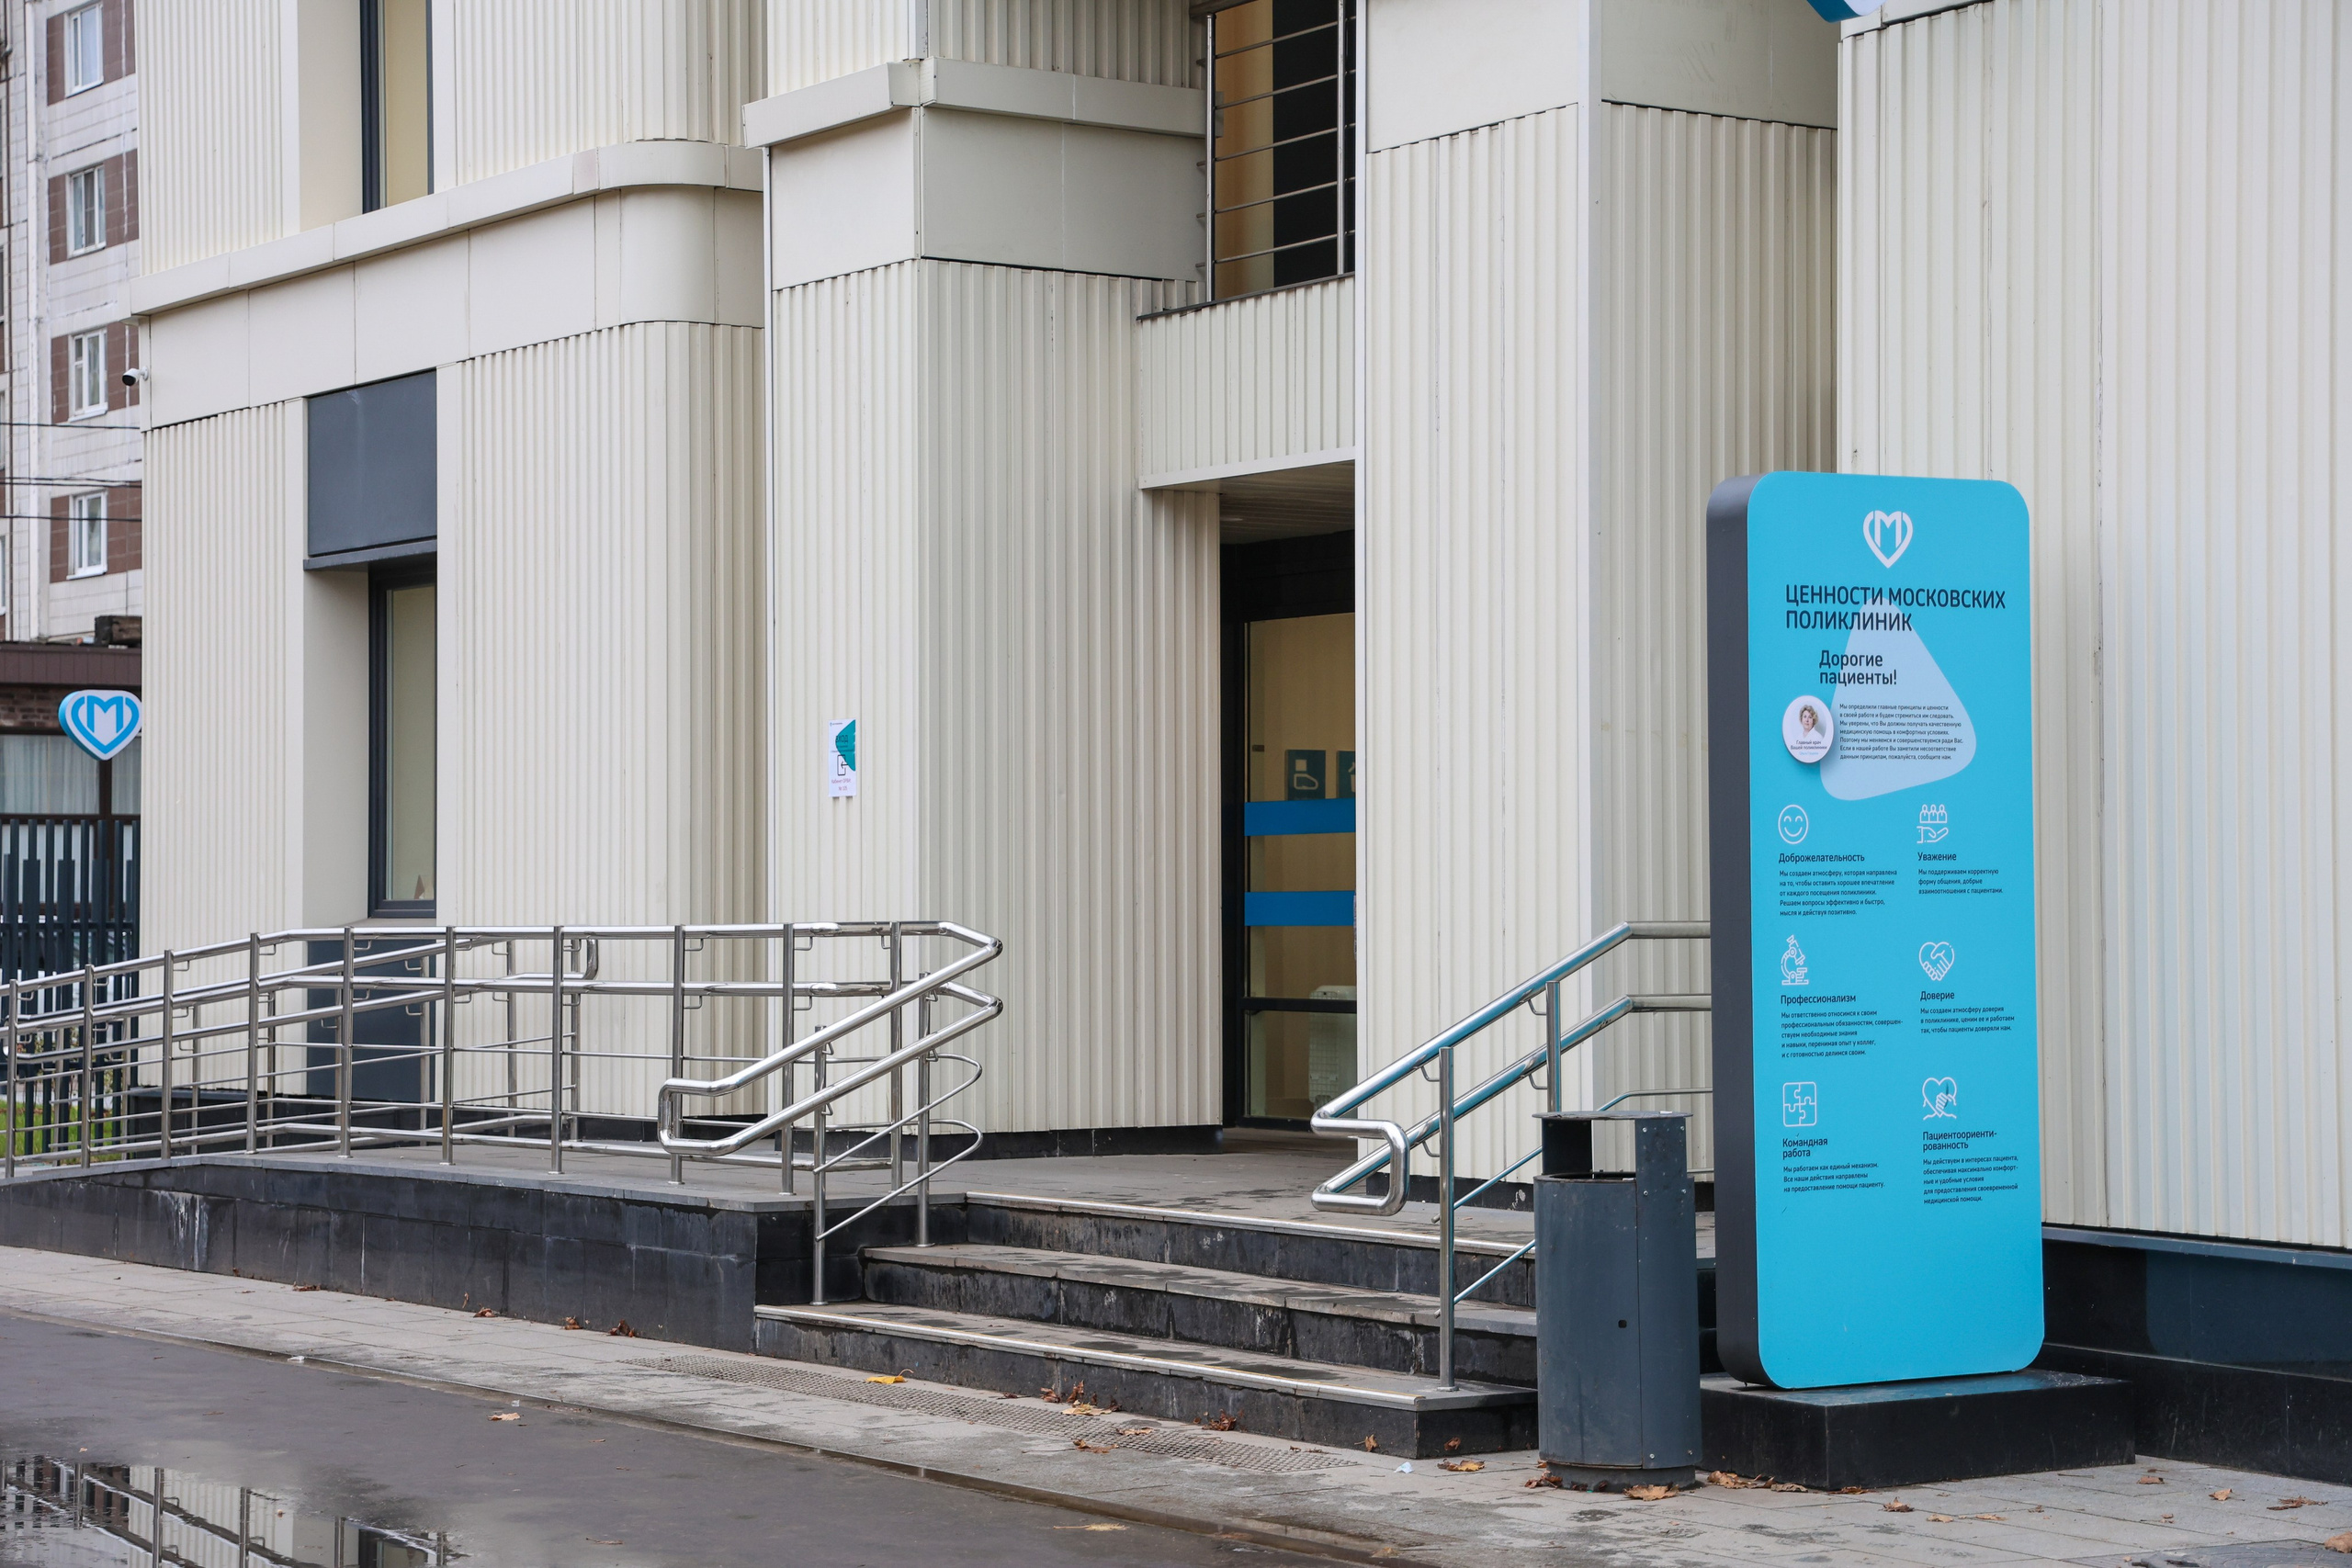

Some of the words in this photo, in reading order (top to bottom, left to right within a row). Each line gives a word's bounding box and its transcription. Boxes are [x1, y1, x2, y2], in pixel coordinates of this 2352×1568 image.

[1786, 584, 1883, 606] ЦЕННОСТИ
[1888, 587, 2006, 609] МОСКОВСКИХ
[1786, 610, 1912, 631] ПОЛИКЛИНИК
[1819, 649, 1883, 670] Дорогие
[1820, 670, 1897, 686] пациенты!
[1779, 852, 1865, 864] Доброжелательность
[1917, 852, 1957, 861] Уважение
[1781, 995, 1857, 1006] Профессионализм
[1920, 991, 1955, 1001] Доверие
[1952, 1006, 1982, 1014] атмосферу
[1781, 1021, 1835, 1030] профессиональным
[1923, 1131, 1997, 1141] Пациентоориенти-
[1782, 1138, 1828, 1147] Командная
[1923, 1142, 1969, 1153] рованность
[1783, 1148, 1811, 1160] работа
[1933, 1157, 1961, 1166] действуем
[1793, 1165, 1819, 1173] работаем
[1993, 1165, 2018, 1173] комфорт-
[1939, 1177, 1962, 1185] удобные
[1792, 1185, 1835, 1193] предоставление
[1934, 1187, 1977, 1195] предоставления
[1978, 1183, 2018, 1192] своевременной
[1924, 1196, 1959, 1204] медицинской
